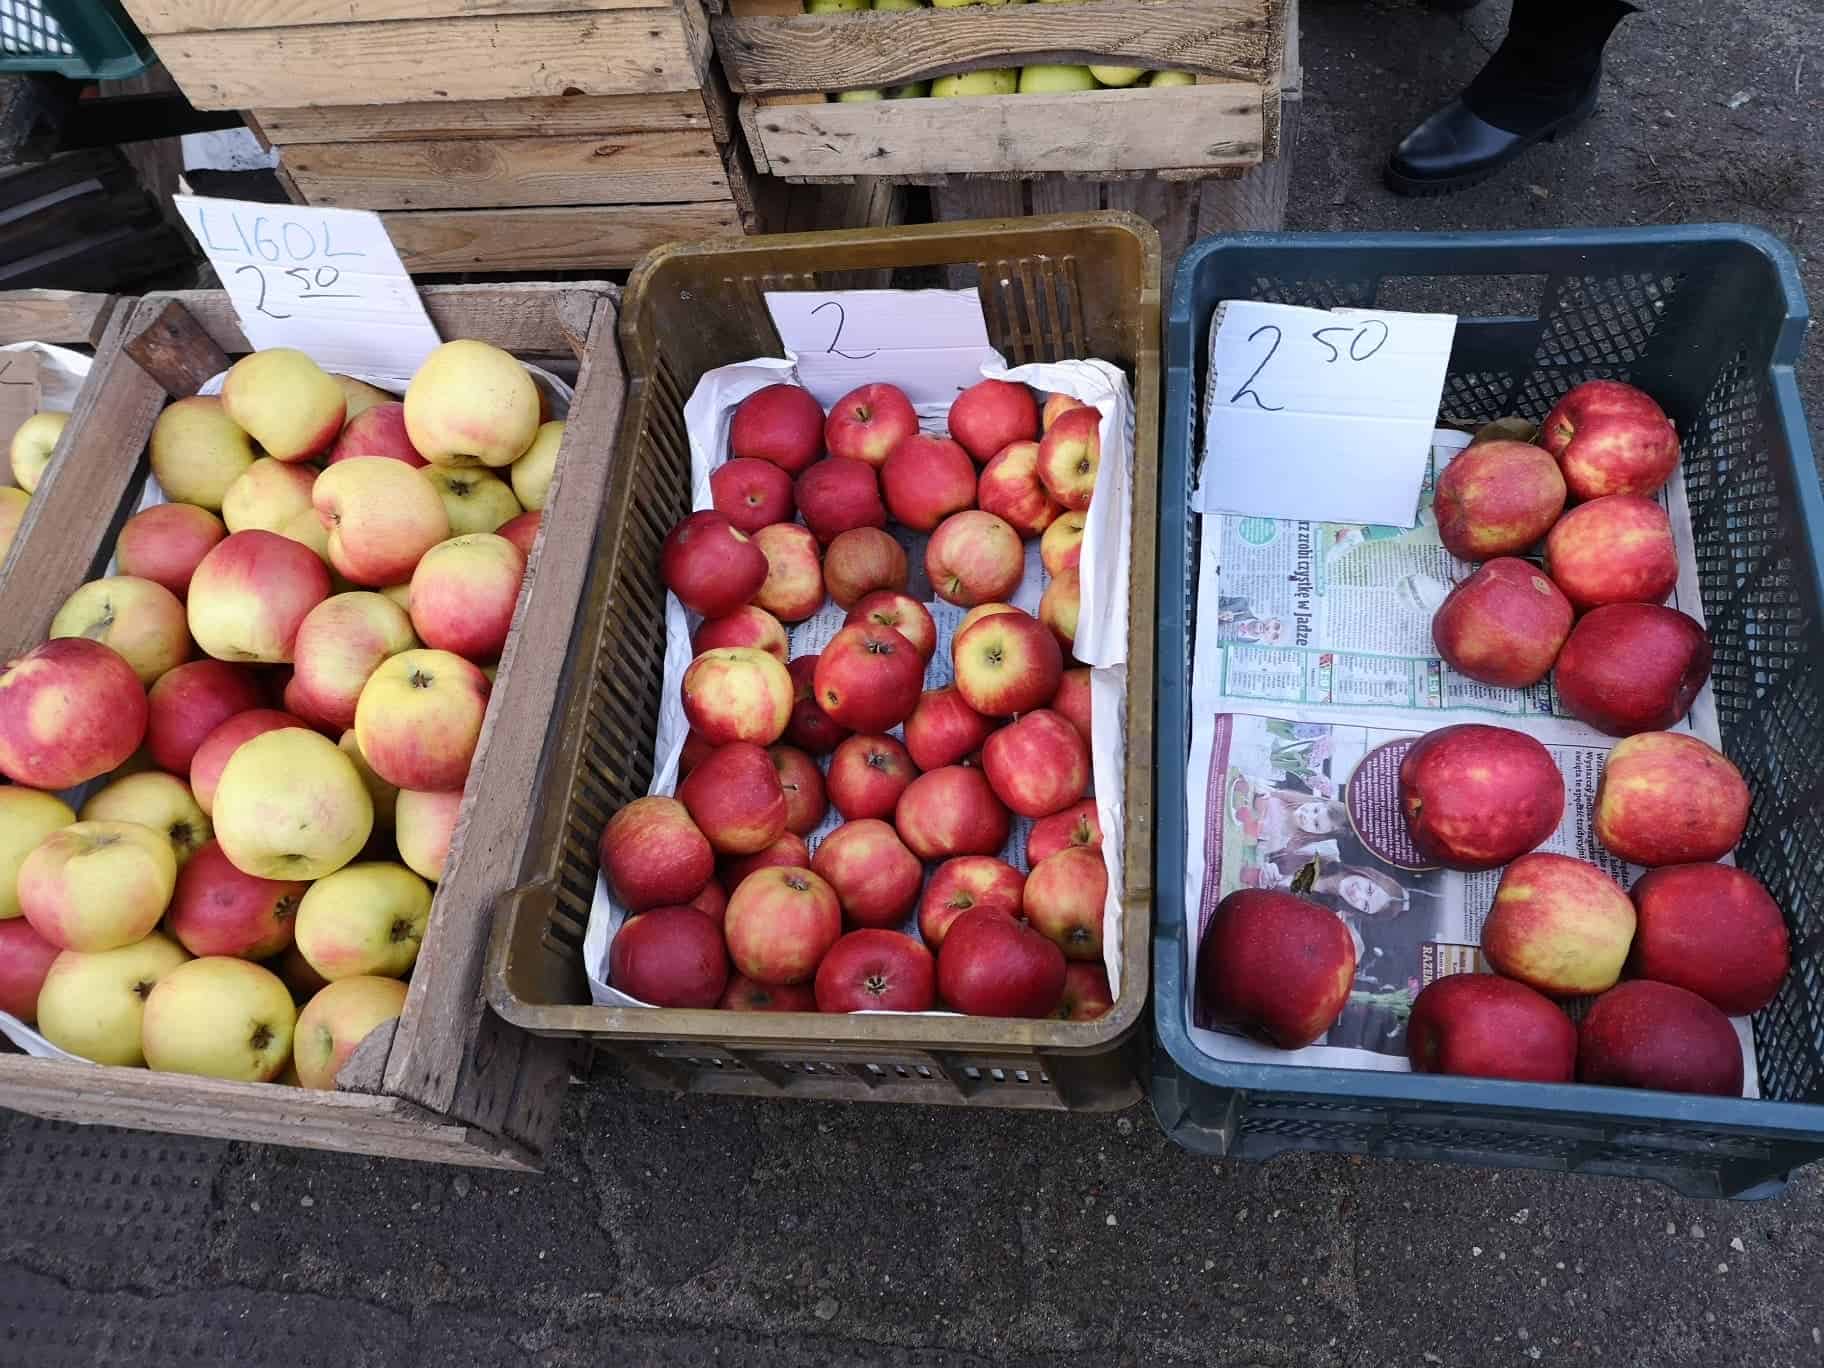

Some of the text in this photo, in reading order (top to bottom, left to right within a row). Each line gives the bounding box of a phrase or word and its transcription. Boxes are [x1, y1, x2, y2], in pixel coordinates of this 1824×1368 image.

[234, 264, 293, 319] 2
[811, 301, 881, 360] 2
[1230, 319, 1389, 412] 2 50
[1298, 533, 1313, 559] zrobi
[1294, 561, 1313, 598] czystkę
[1298, 601, 1310, 611] w
